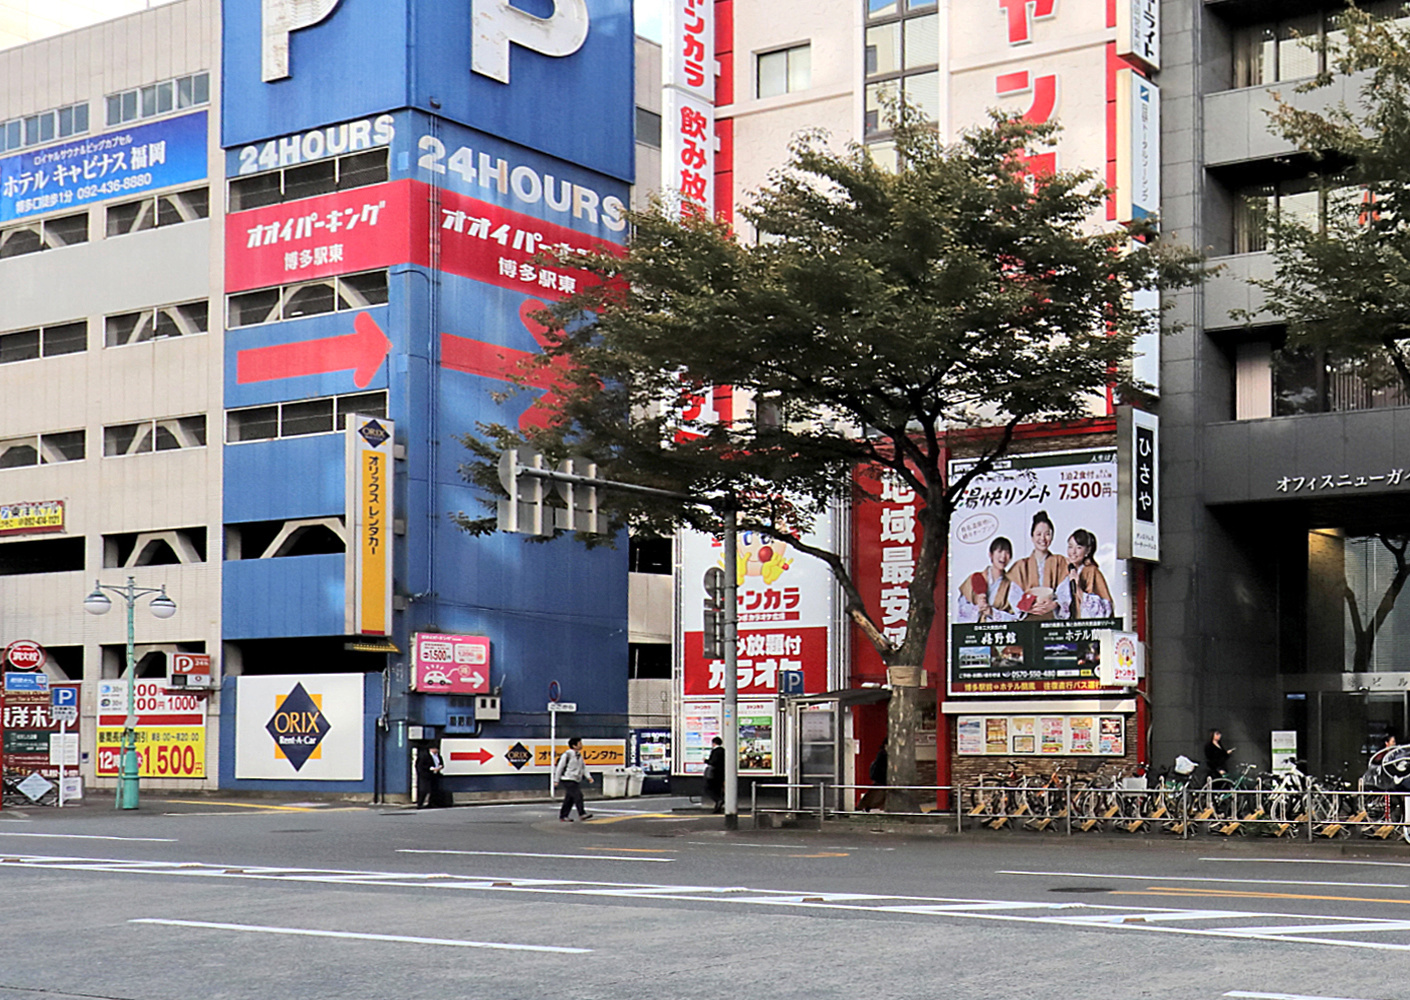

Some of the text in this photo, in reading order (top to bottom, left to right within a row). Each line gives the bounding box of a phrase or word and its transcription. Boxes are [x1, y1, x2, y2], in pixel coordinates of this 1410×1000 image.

[239, 114, 395, 175] 24HOURS
[3, 140, 166, 198] ホテル キャビナス 福岡
[680, 105, 708, 226] 飲み放
[77, 173, 152, 200] 092-436-8880
[417, 135, 626, 232] 24HOURS
[247, 201, 386, 249] オオイパーキング
[283, 243, 344, 272] 博多駅東
[498, 256, 577, 295] 博多駅東
[1138, 437, 1152, 511] ひさや
[736, 587, 800, 611] ンカラ
[737, 633, 802, 656] 放題付
[176, 656, 194, 673] P
[59, 689, 73, 705] P
[789, 677, 801, 692] P
[274, 711, 320, 733] ORIX
[99, 750, 126, 770] 12時
[507, 751, 529, 759] ORIX
[539, 749, 624, 762] オリレンタカー
